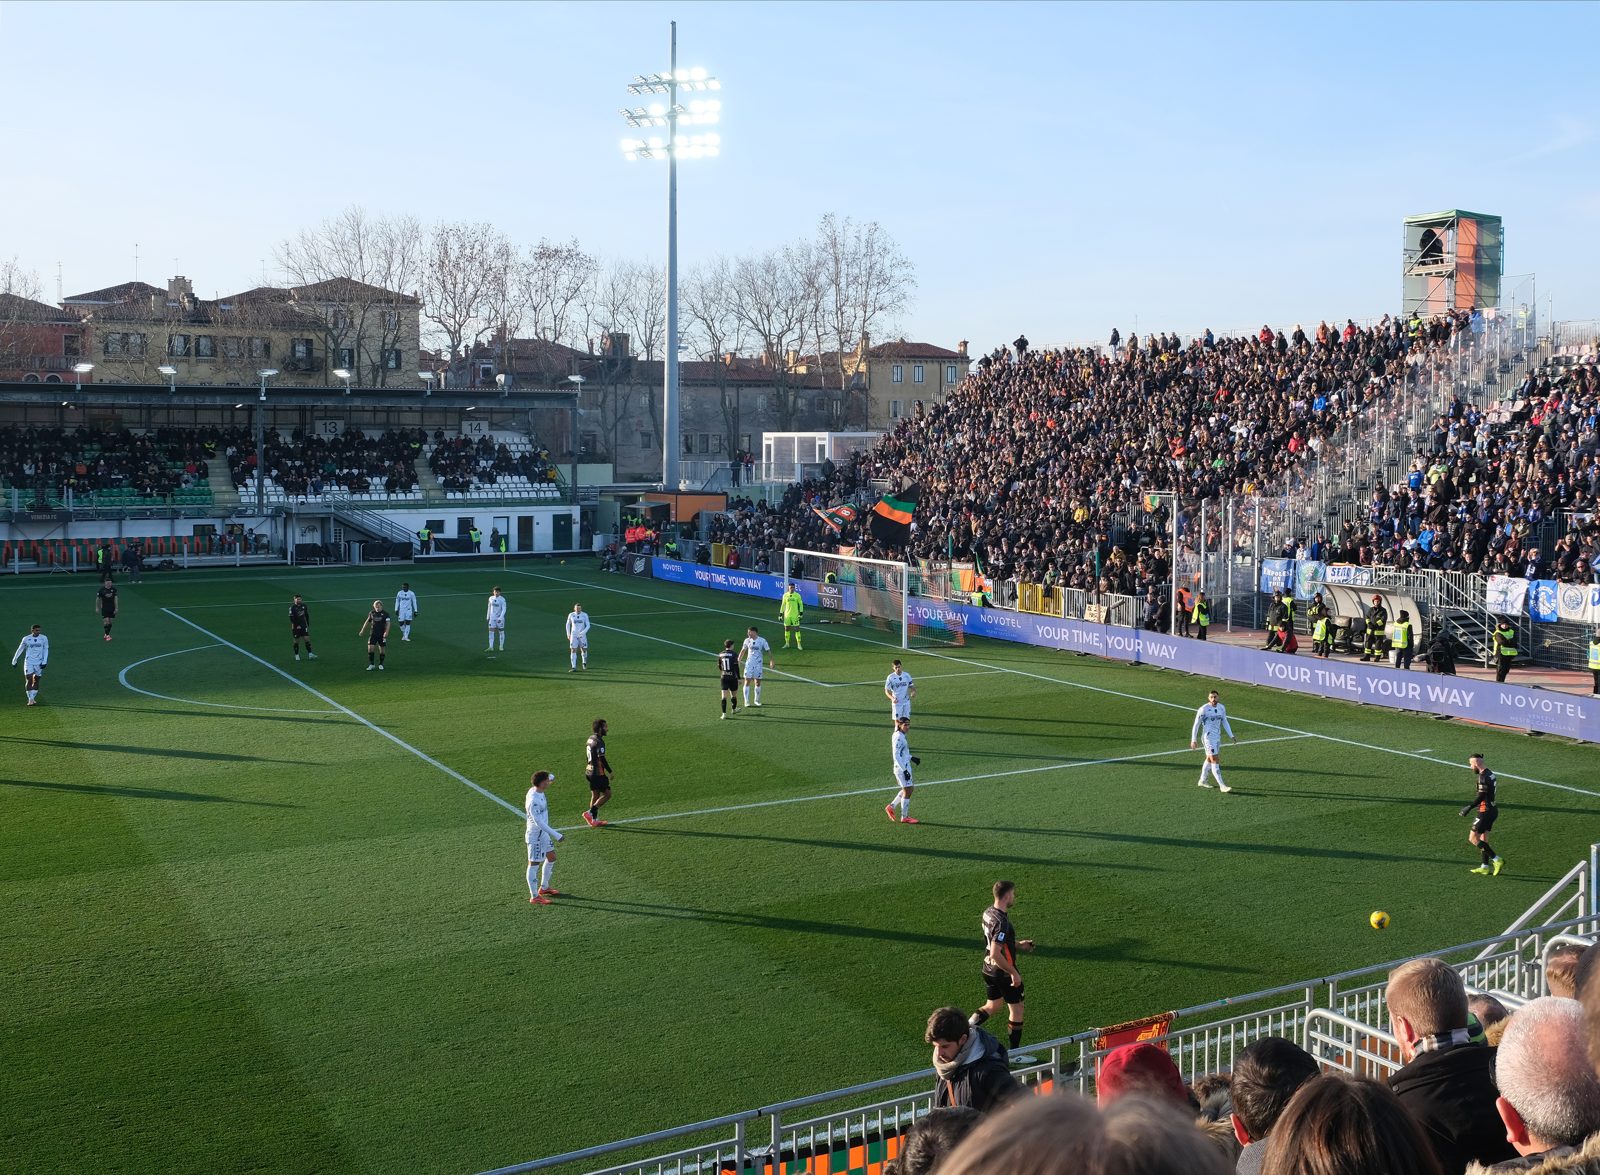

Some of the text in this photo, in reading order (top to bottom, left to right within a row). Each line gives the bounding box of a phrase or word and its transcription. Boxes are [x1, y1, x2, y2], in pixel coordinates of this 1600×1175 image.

[322, 422, 338, 433] 13
[468, 422, 482, 434] 14
[662, 563, 683, 572] NOVOTEL
[694, 570, 761, 590] YOUR TIME, YOUR WAY
[776, 581, 802, 592] NOEL
[823, 597, 838, 608] 09:51
[916, 606, 944, 621] YOUR
[945, 610, 969, 626] WAY
[980, 614, 1022, 628] NOVOTEL
[1036, 625, 1069, 641] YOUR
[1072, 629, 1103, 649] TIME,
[1106, 635, 1143, 653] YOUR
[1146, 640, 1178, 660] WAY
[722, 658, 730, 670] 11
[1264, 662, 1474, 708] YOUR TIME, YOUR WAY
[1500, 692, 1586, 719] NOVOTEL
